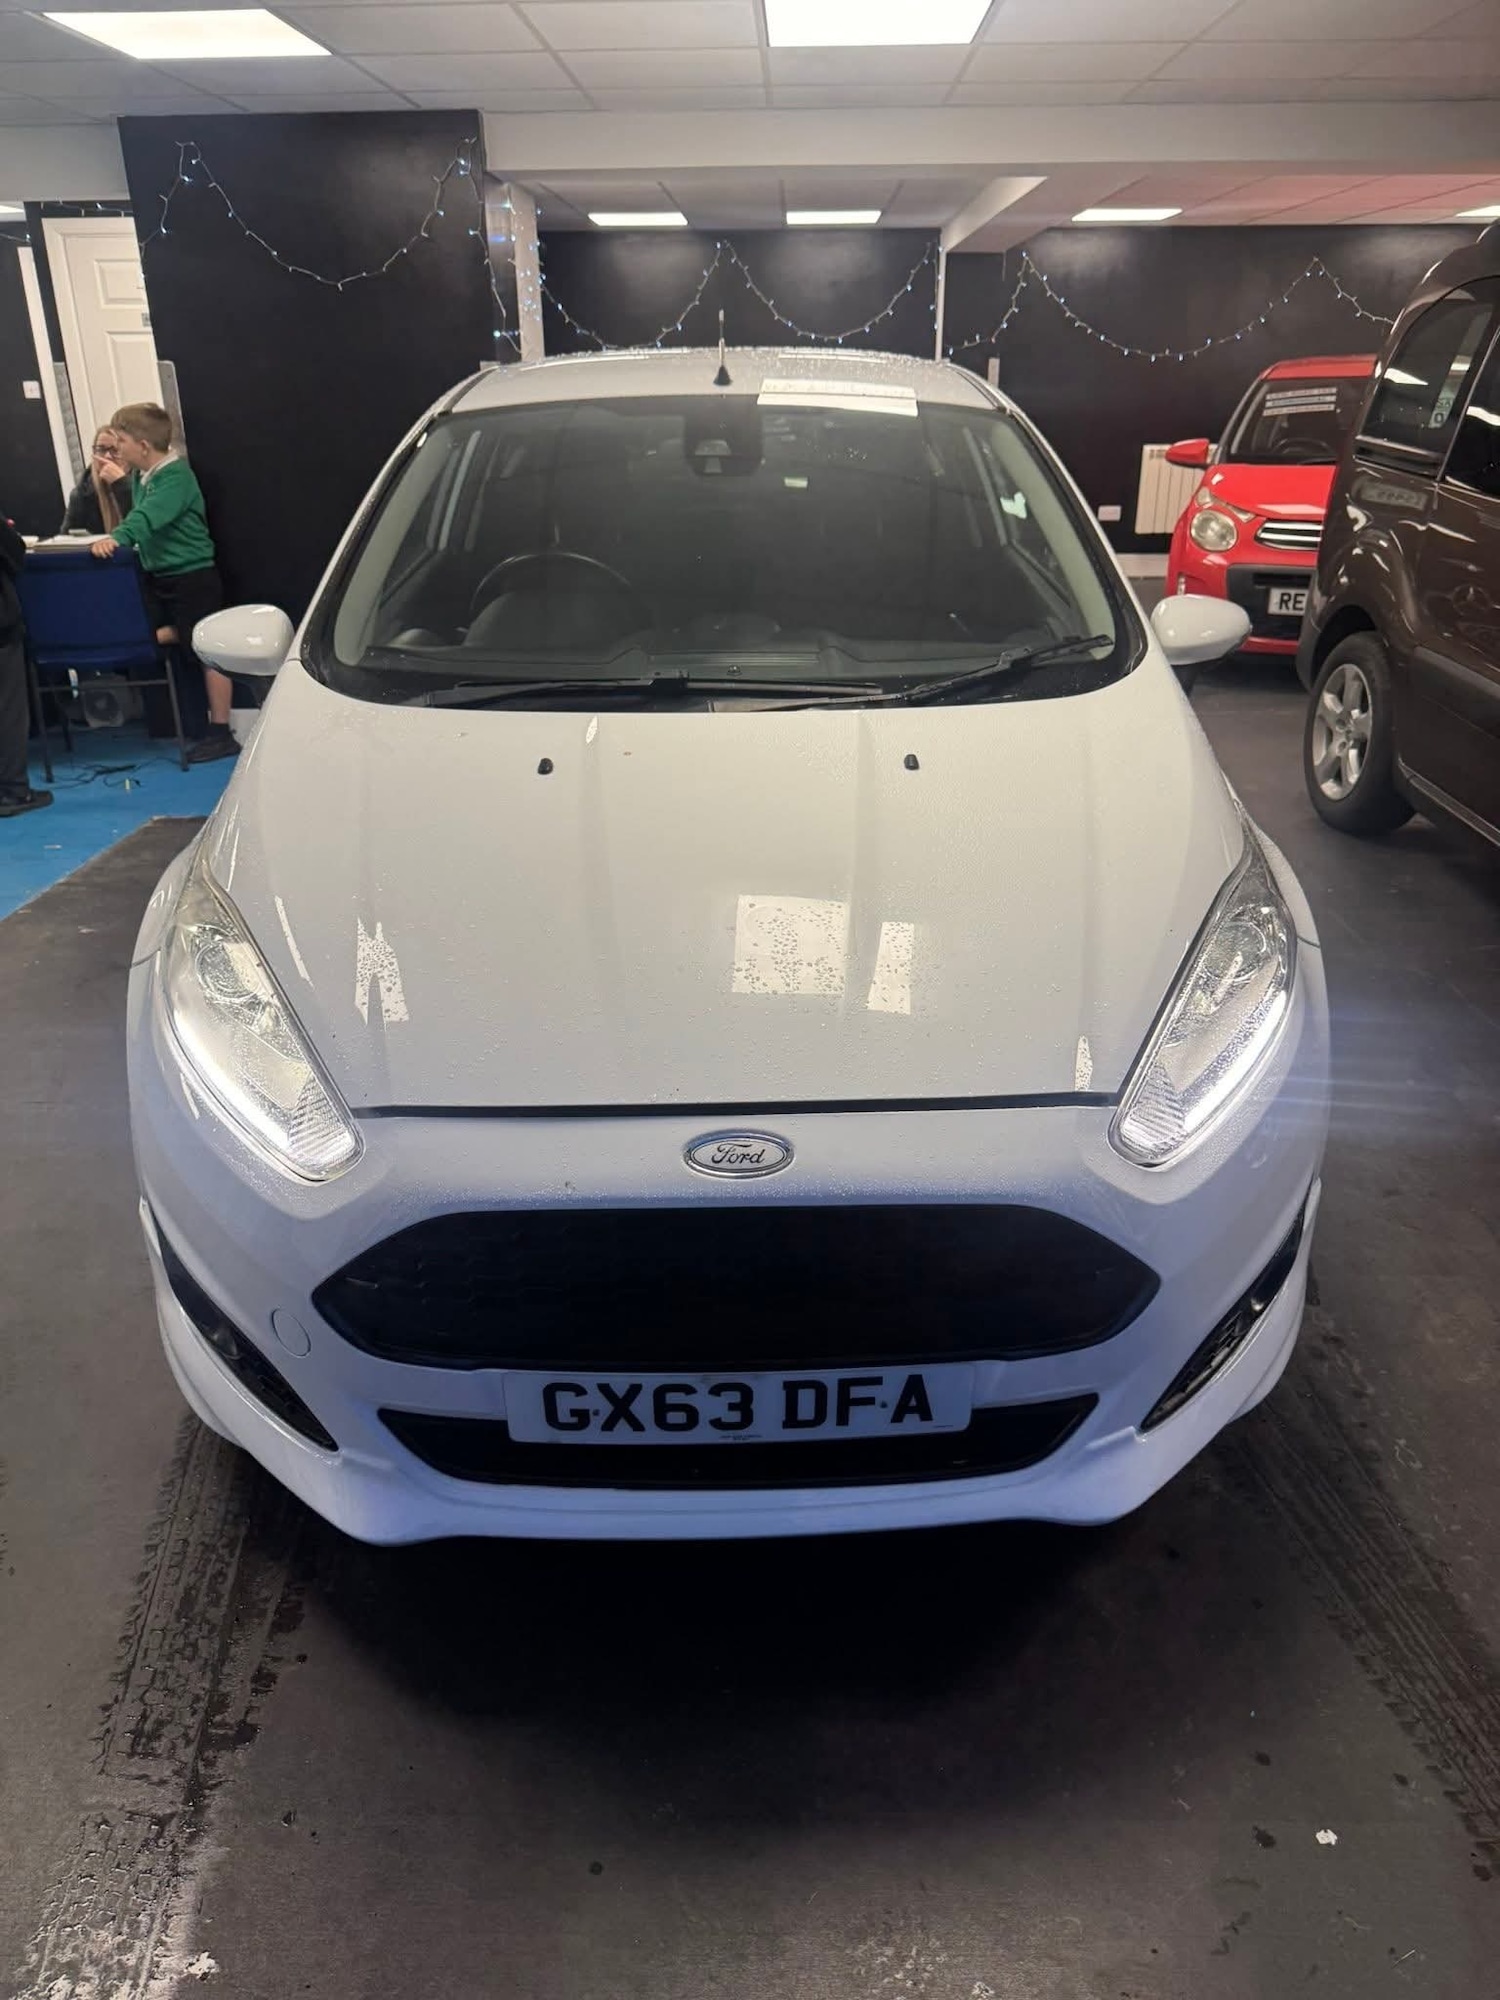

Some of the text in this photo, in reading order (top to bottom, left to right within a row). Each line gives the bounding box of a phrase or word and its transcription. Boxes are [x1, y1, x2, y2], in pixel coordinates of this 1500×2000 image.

[711, 1143, 766, 1164] Ford
[542, 1374, 934, 1432] GX63 DFA
